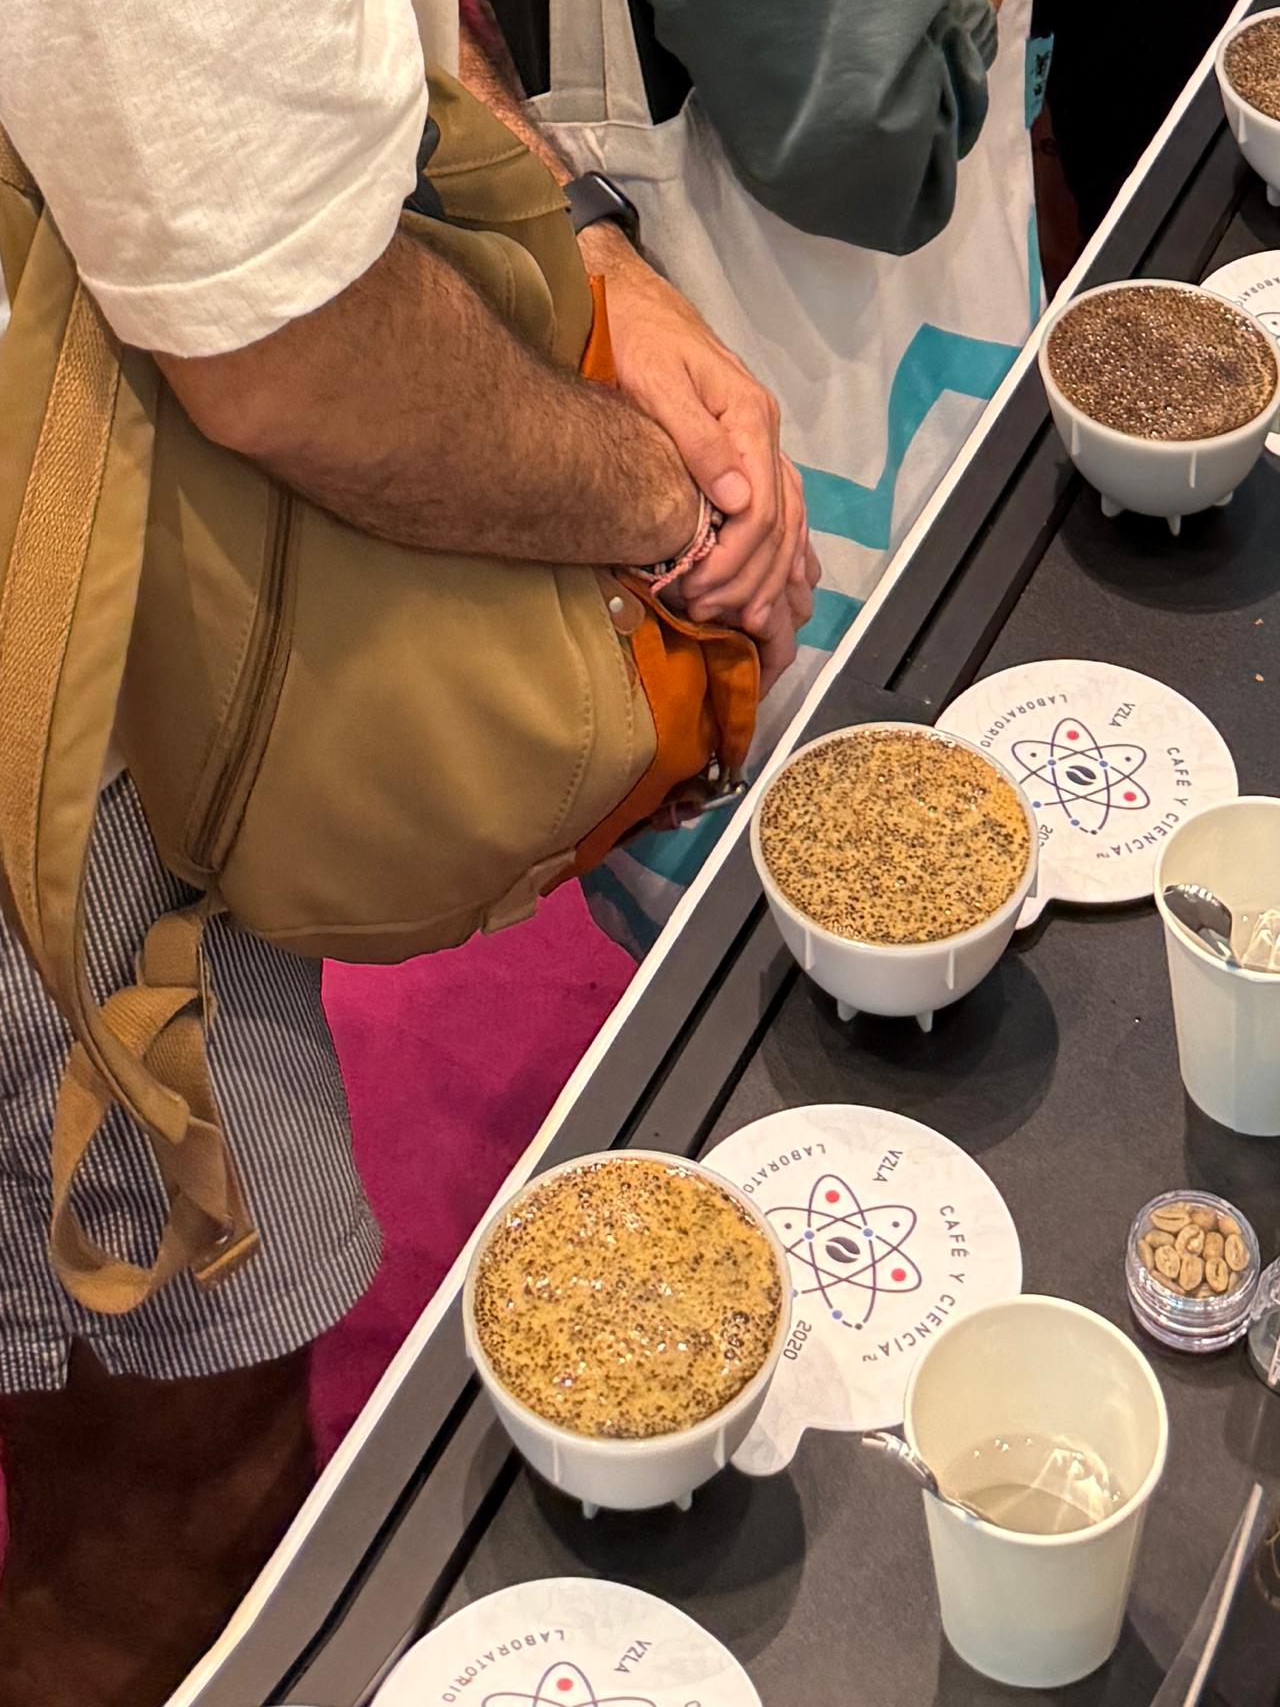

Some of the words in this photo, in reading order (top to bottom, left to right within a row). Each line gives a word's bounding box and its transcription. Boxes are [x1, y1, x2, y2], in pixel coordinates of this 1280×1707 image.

[980, 693, 1068, 748] LABORATORIO
[1108, 701, 1136, 728] VZLA
[1166, 746, 1193, 788] CAFÉ
[1175, 796, 1189, 807] Y
[742, 1143, 827, 1194] LABORATO
[872, 1149, 904, 1184] VZLA
[939, 1204, 970, 1259] CAFÉ
[948, 1272, 966, 1284] Y
[782, 1319, 813, 1361] 2020
[441, 1629, 565, 1704] LABORATORIO
[613, 1638, 653, 1674] VZLA
